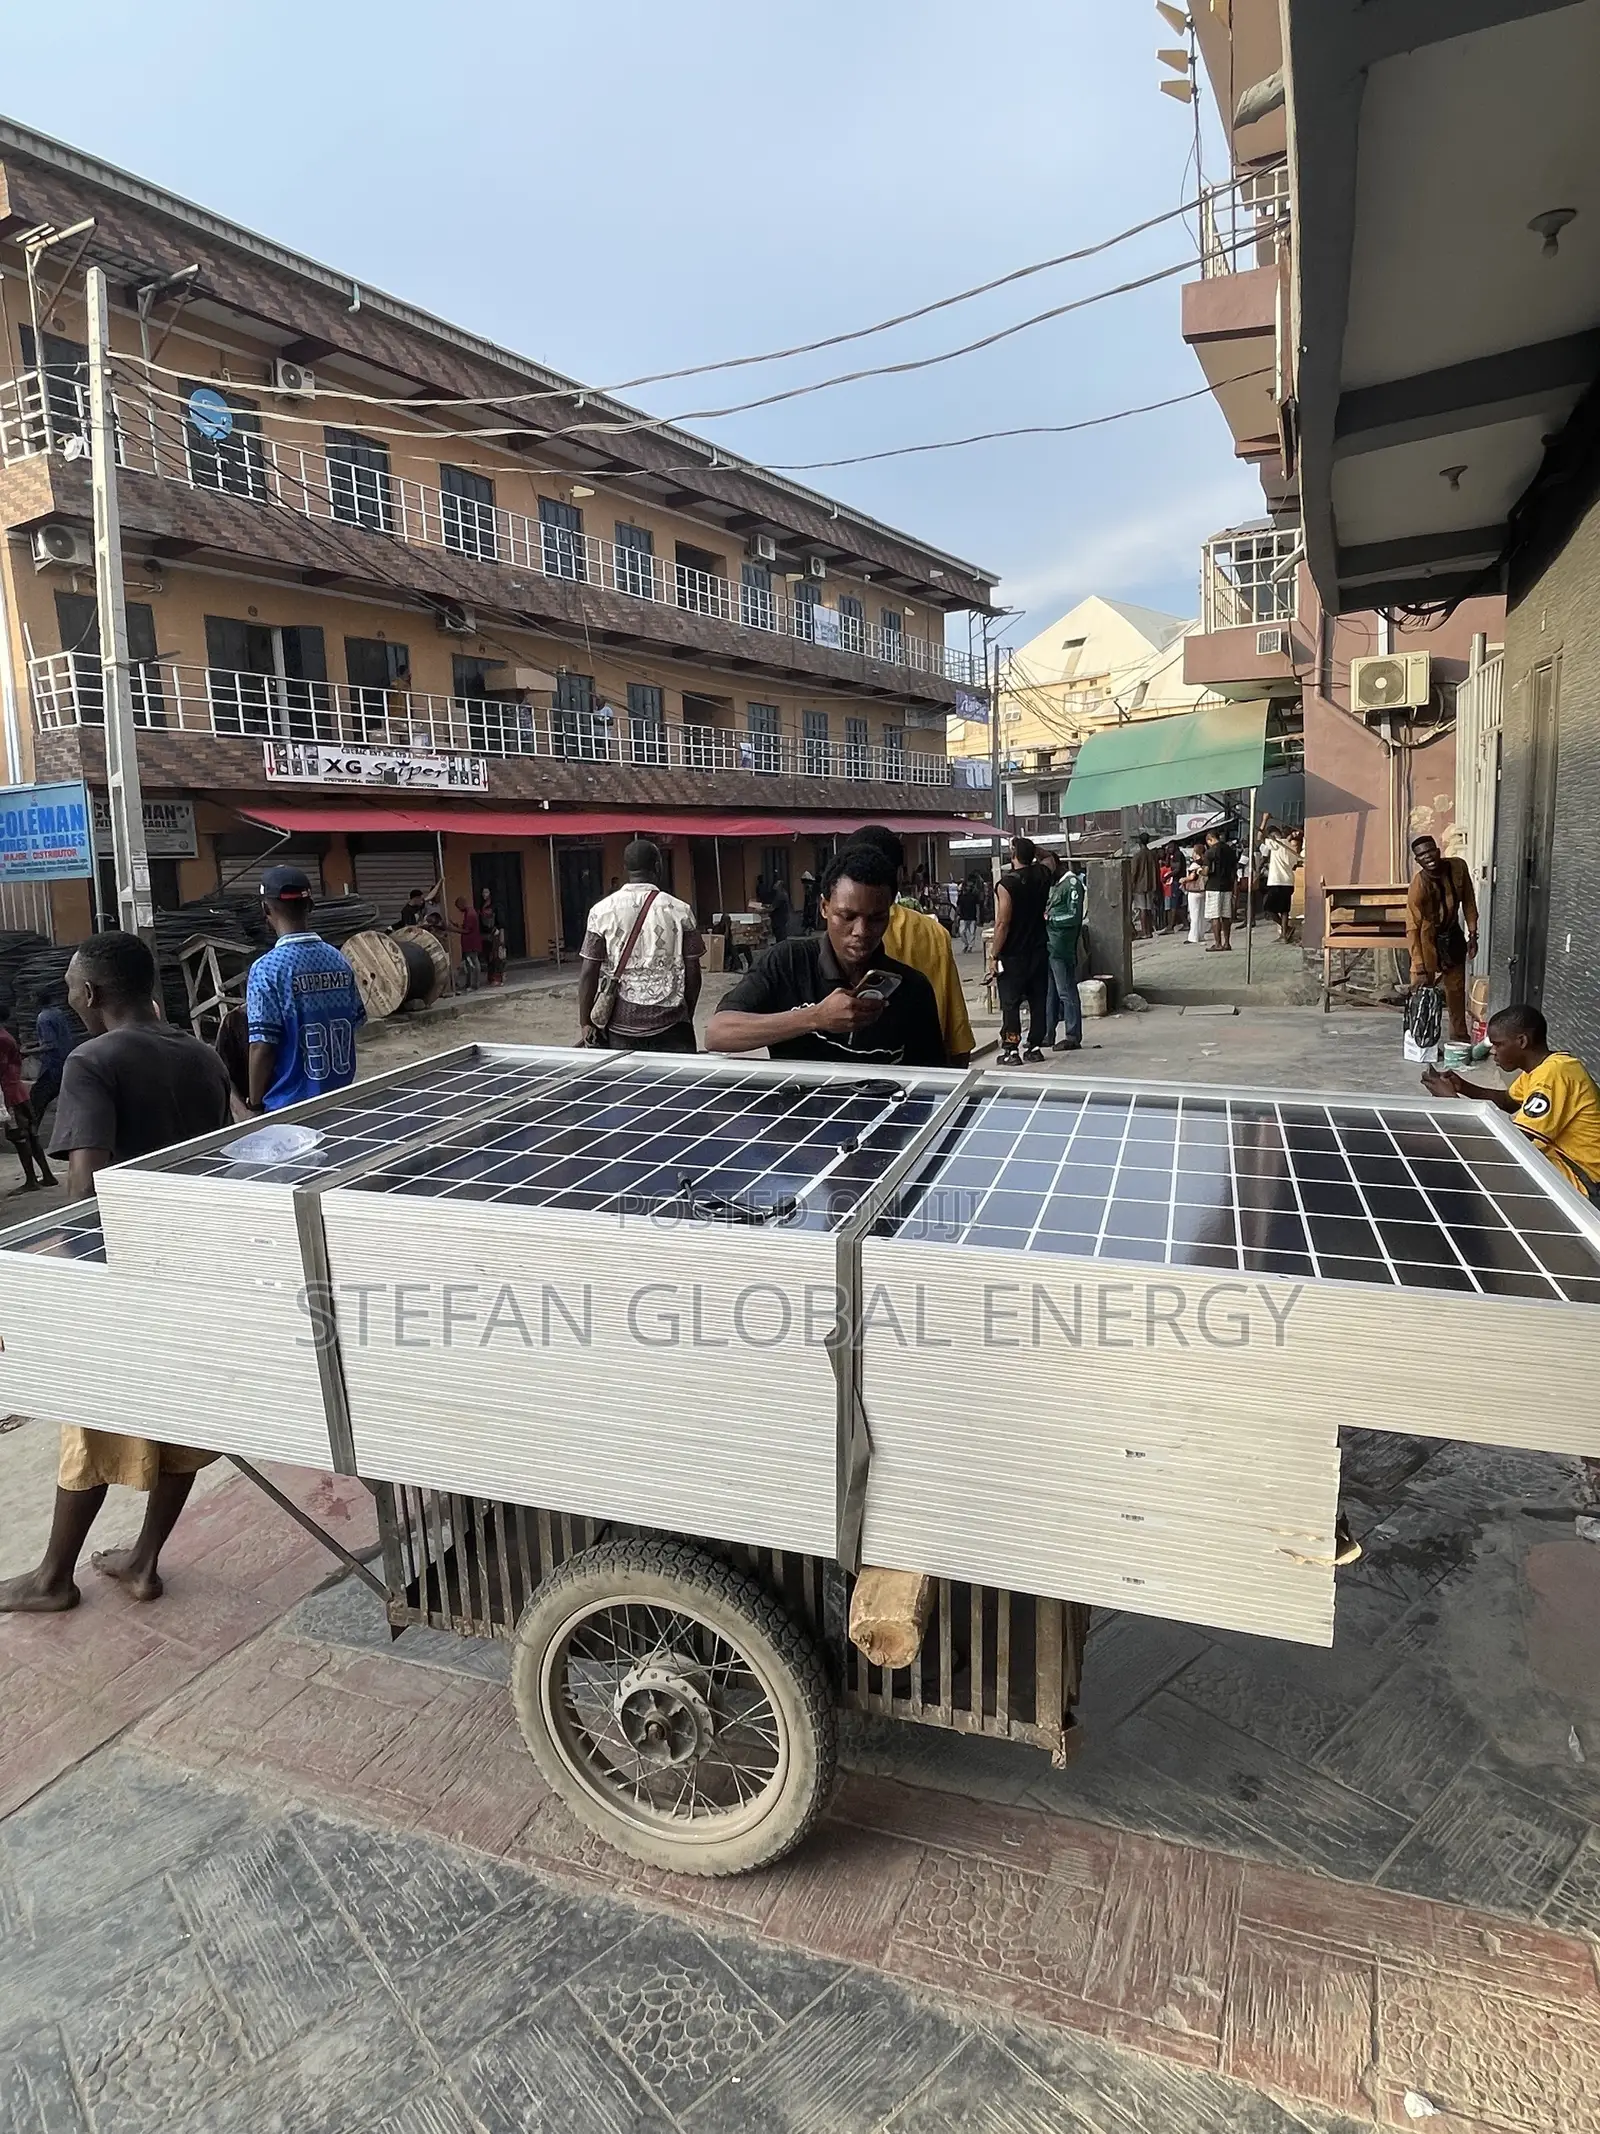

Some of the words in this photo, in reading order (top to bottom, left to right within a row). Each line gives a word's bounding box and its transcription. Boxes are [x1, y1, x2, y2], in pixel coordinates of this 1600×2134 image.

[324, 758, 362, 774] XG
[94, 802, 177, 820] COMAN
[43, 833, 86, 849] CABLES
[3, 852, 28, 861] MAJOR
[32, 848, 77, 860] DISTRIBUTOR
[292, 971, 350, 994] SUPREME
[301, 1018, 352, 1080] 80
[1524, 1097, 1548, 1113] JD
